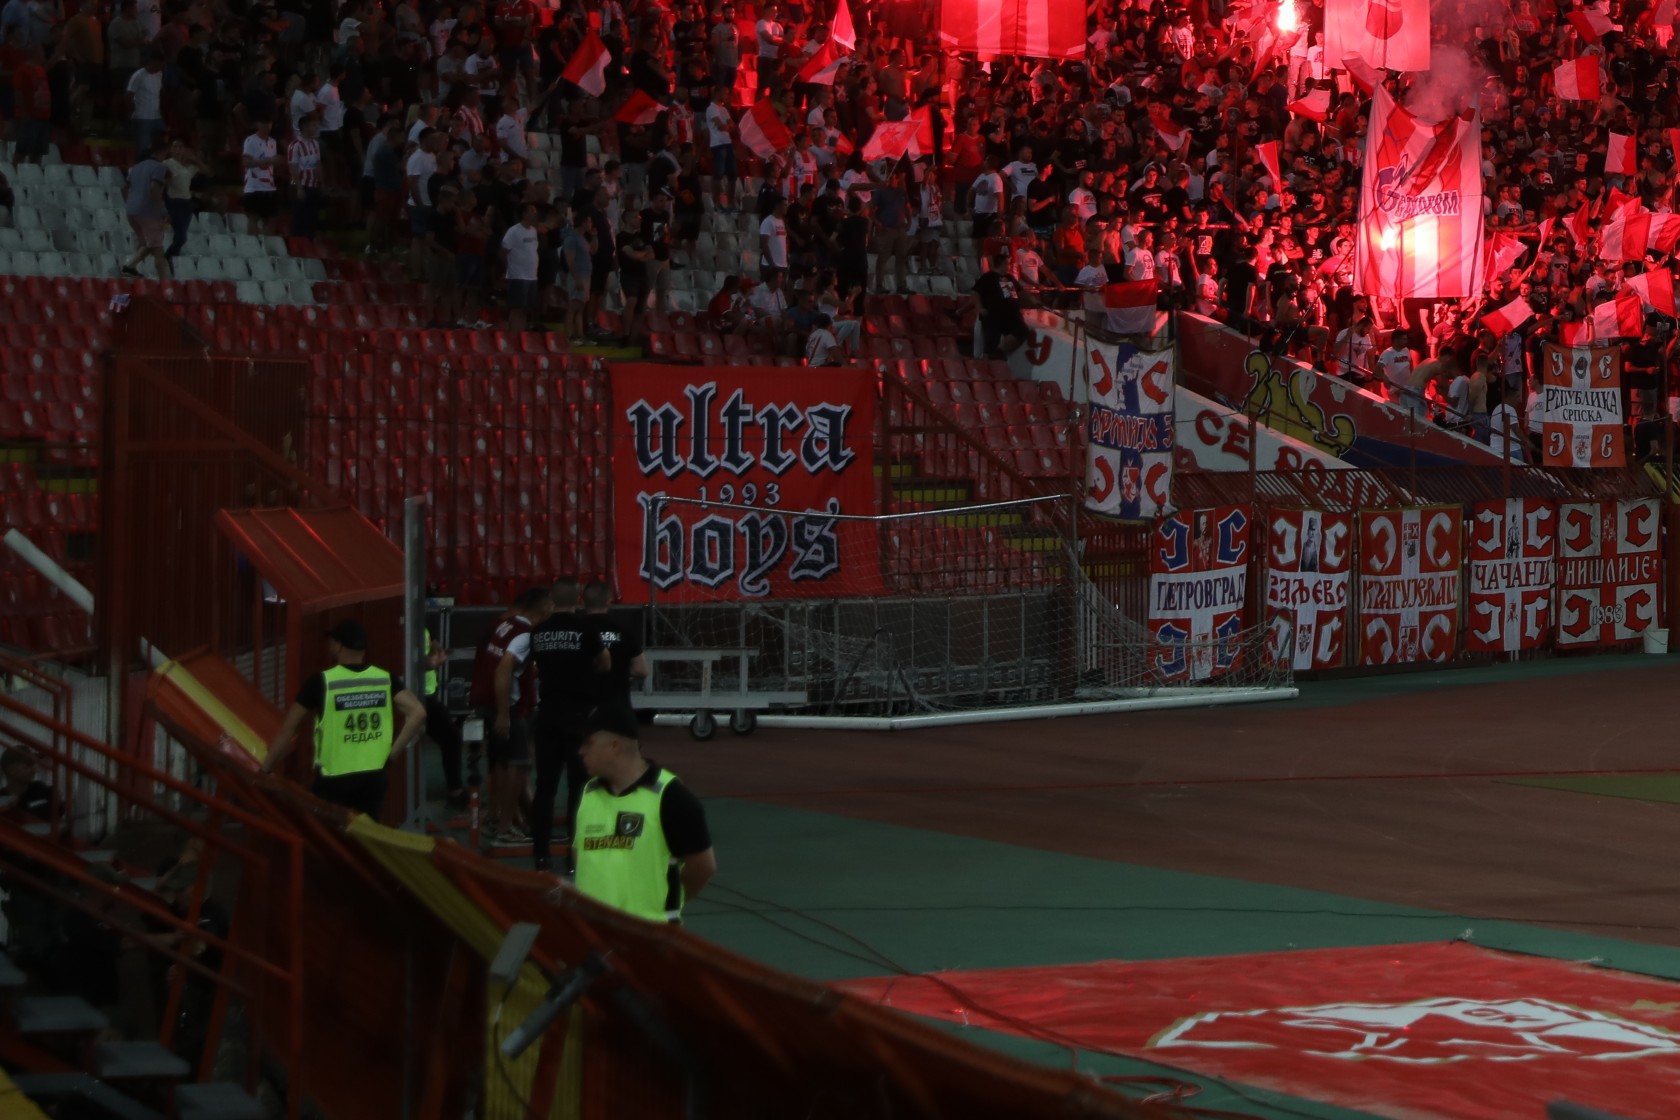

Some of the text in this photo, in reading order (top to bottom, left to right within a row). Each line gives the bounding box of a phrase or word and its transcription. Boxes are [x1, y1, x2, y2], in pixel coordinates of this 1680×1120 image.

[1545, 388, 1618, 415] РЕПУБЛИКА
[1562, 409, 1602, 422] СРПСКА
[626, 381, 855, 477] ultra
[699, 482, 781, 509] 1993
[636, 490, 840, 597] boys
[1592, 604, 1624, 626] 1986
[533, 631, 583, 643] SECURITY
[344, 699, 379, 708] SECURITY
[344, 711, 381, 733] 469
[344, 731, 382, 743] РЕДАР
